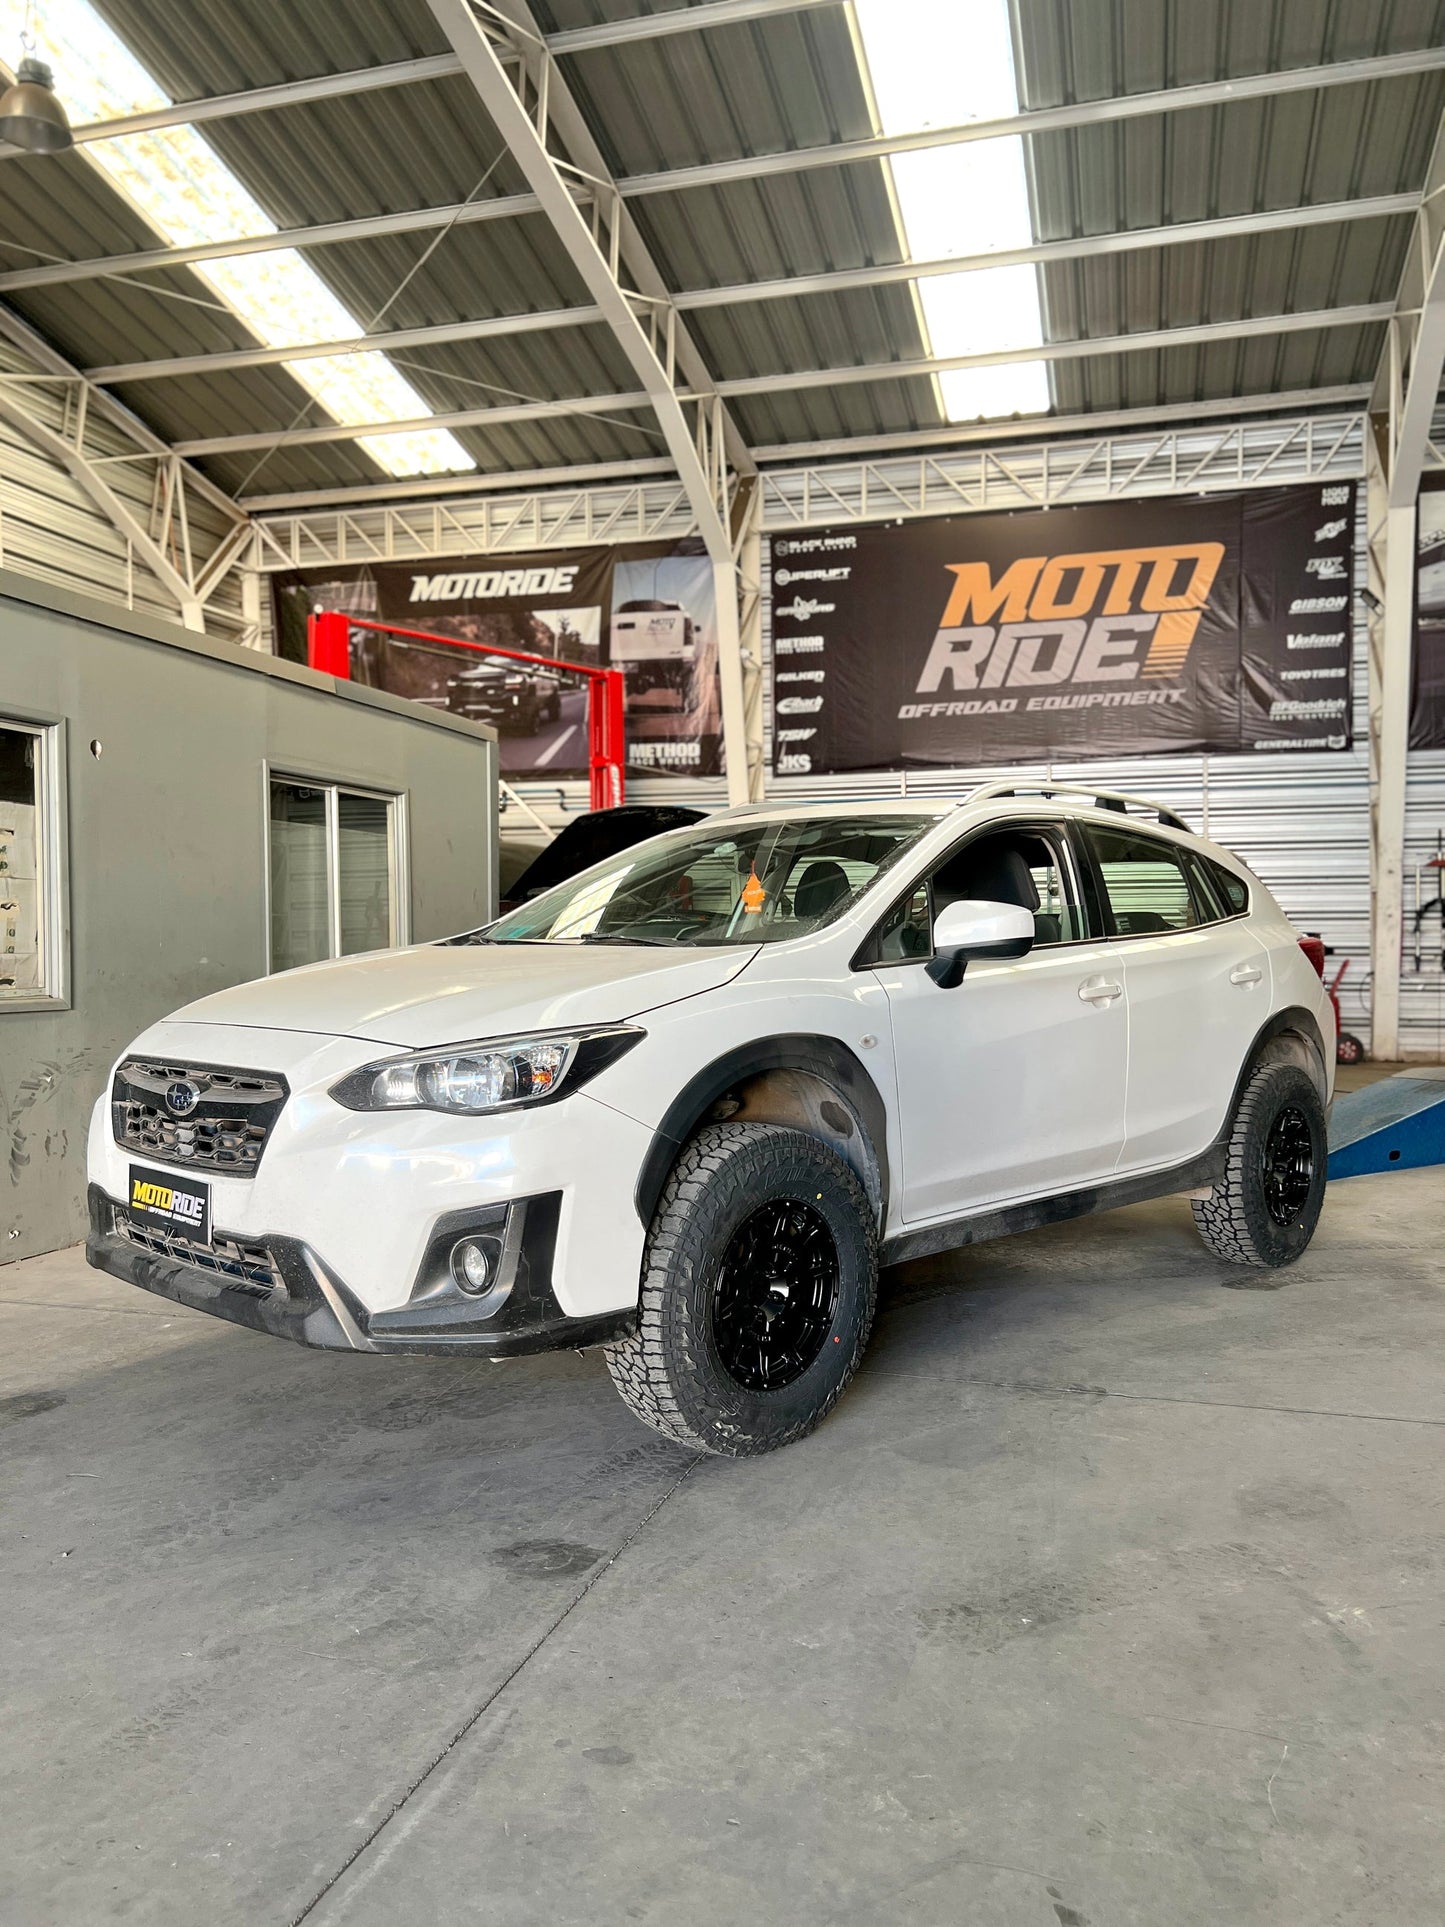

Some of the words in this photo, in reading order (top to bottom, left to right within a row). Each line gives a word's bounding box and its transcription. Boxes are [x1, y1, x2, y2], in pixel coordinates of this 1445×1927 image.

[1321, 496, 1349, 506] MOLY
[409, 566, 579, 602] MOTORIDE
[939, 541, 1226, 628] MOTO
[1290, 596, 1348, 610] GIBSON
[775, 635, 824, 648] METHOD
[915, 613, 1161, 693] RIDE
[898, 698, 1020, 719] OFFROAD
[1025, 688, 1187, 712] EQUIPMENT
[629, 742, 701, 757] METHOD
[659, 756, 701, 765] WHEELS
[777, 753, 812, 771] JKS
